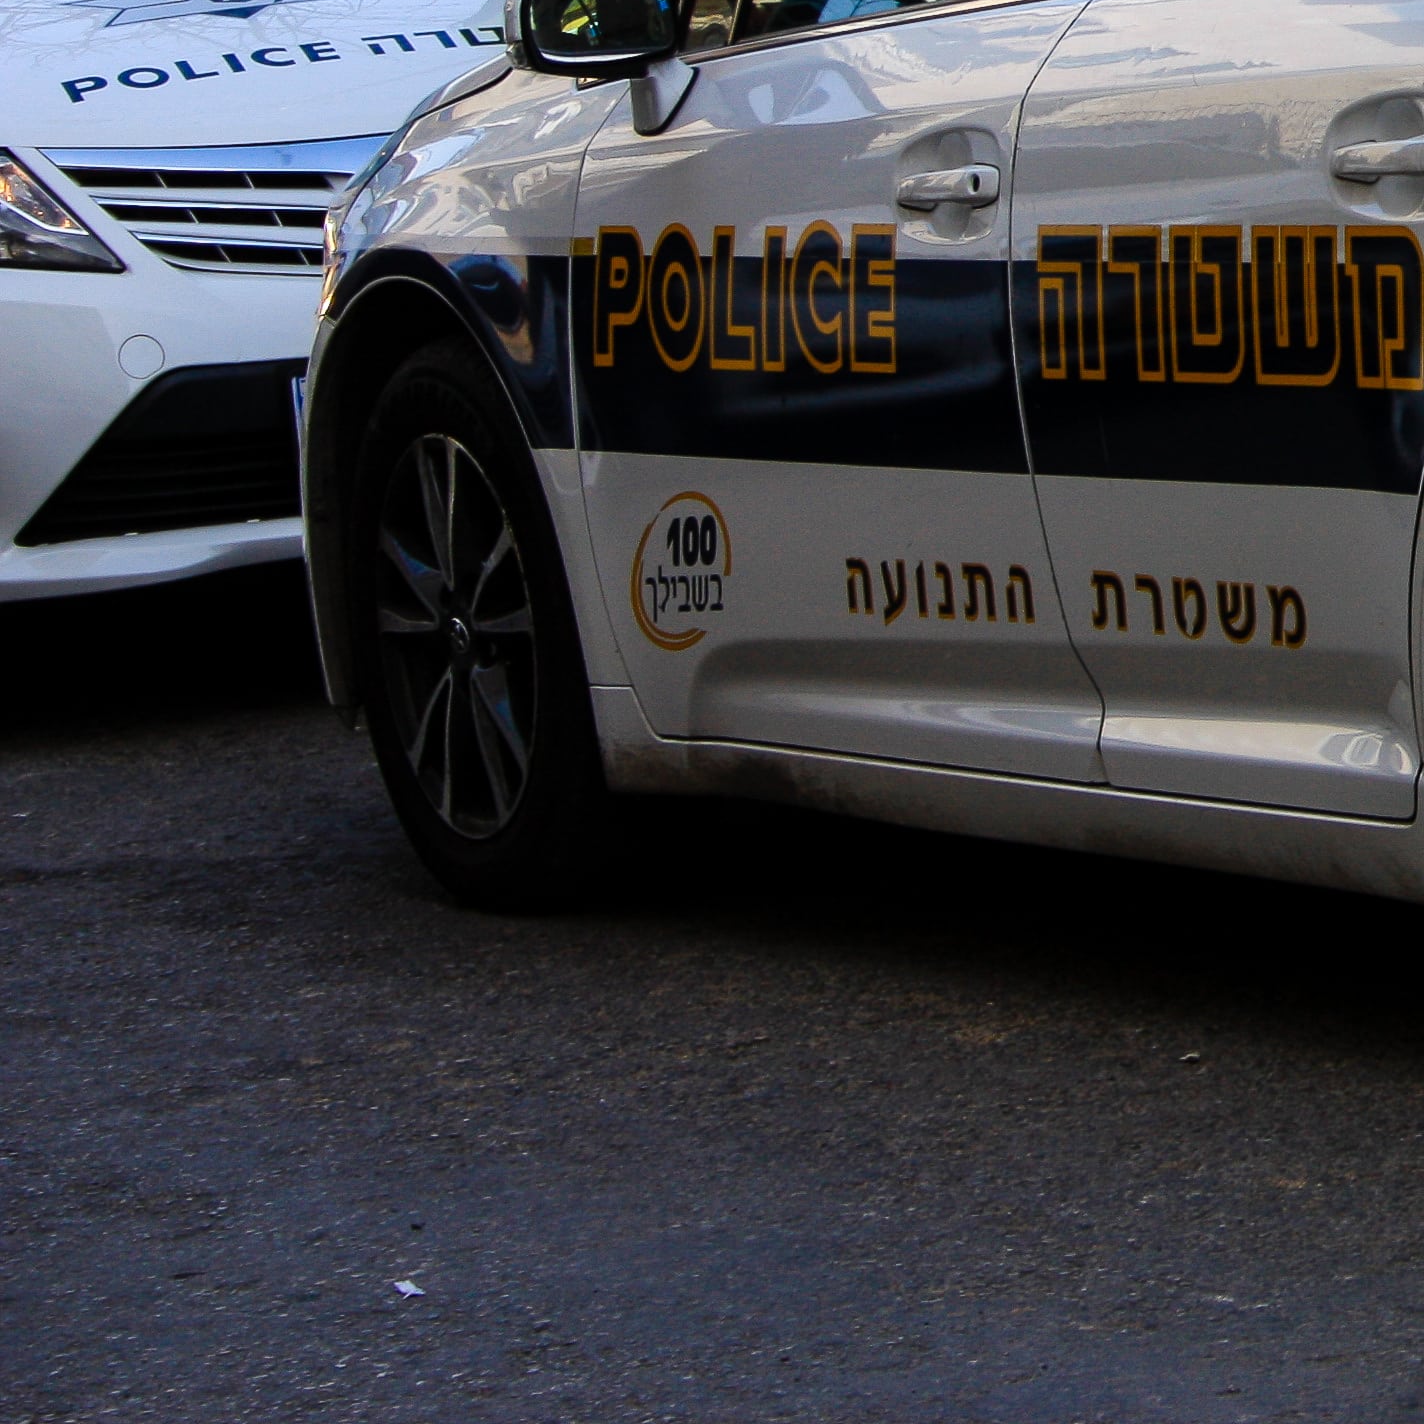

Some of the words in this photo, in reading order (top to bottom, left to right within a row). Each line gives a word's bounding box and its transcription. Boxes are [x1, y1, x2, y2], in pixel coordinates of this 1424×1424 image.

[61, 41, 341, 104] POLICE
[594, 219, 897, 374] POLICE
[667, 515, 717, 567] 100
[645, 565, 724, 624] בשבילך
[845, 556, 1036, 628] התנועה
[1090, 569, 1309, 650] משטרת
